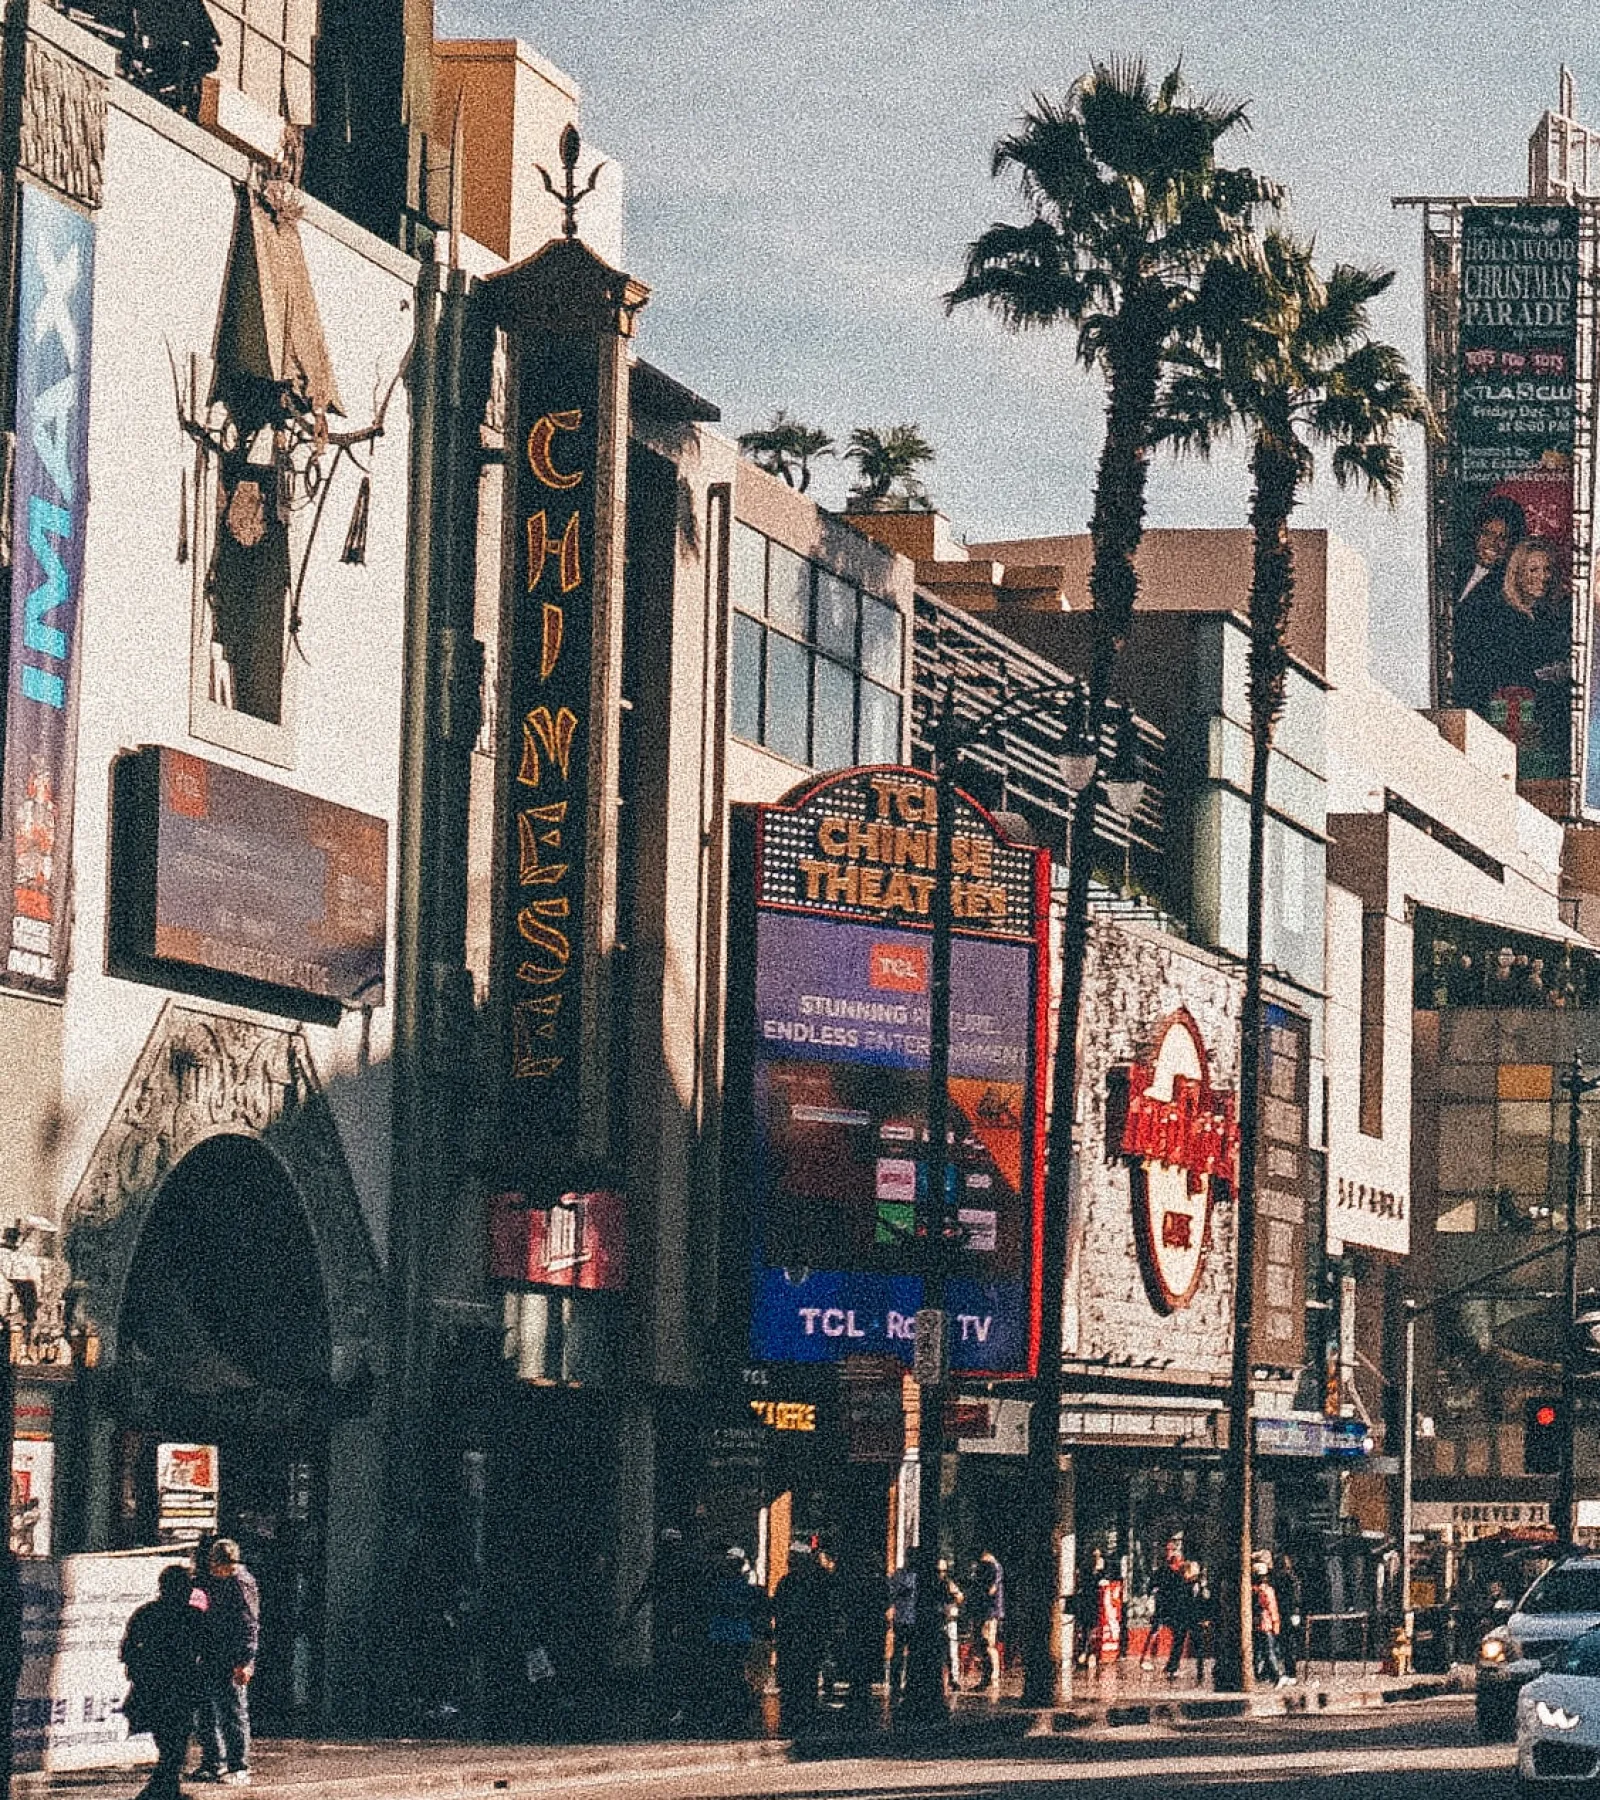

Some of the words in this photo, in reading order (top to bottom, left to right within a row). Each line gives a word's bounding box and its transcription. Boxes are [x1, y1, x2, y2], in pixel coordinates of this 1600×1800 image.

[1465, 239, 1575, 262] HOLLYWOOD
[1465, 265, 1572, 300] CHRISTMAS
[1464, 302, 1572, 326] PARADE
[21, 236, 80, 709] IMAX
[515, 408, 583, 1078] CHINESE
[879, 956, 920, 979] TCL
[801, 995, 908, 1025] STUNNING
[763, 1020, 859, 1048] ENDLESS
[799, 1308, 865, 1338] TCL
[957, 1314, 993, 1343] TV
[1452, 1504, 1520, 1522] FOREVER
[1529, 1504, 1544, 1522] 21
